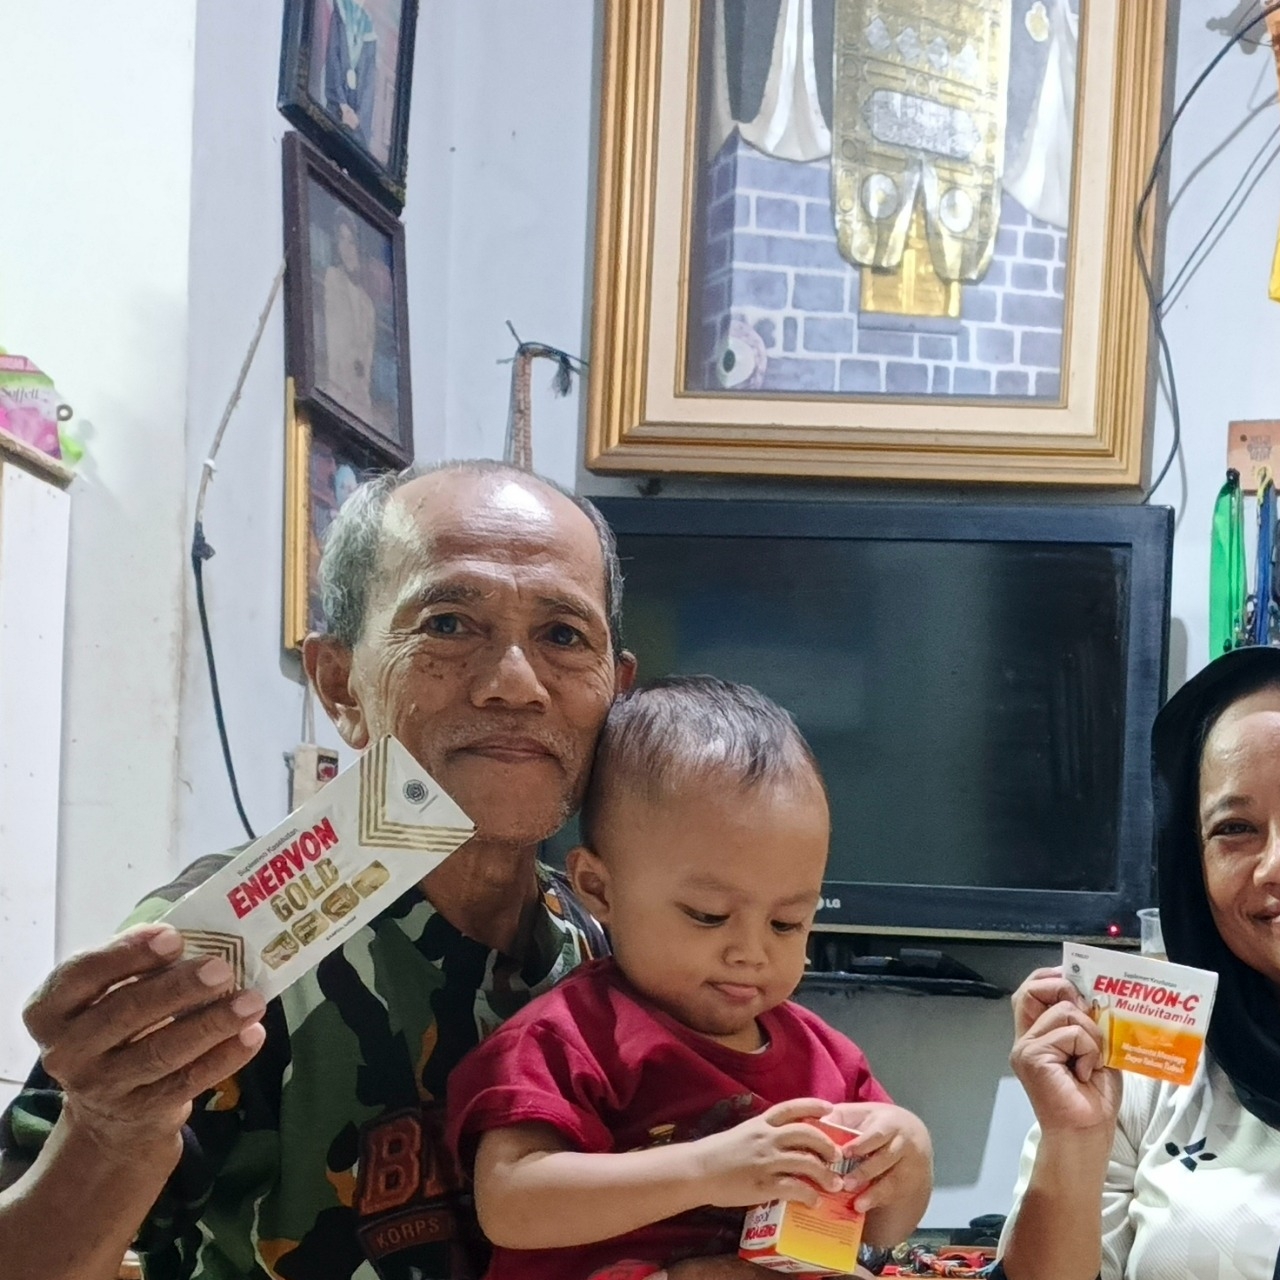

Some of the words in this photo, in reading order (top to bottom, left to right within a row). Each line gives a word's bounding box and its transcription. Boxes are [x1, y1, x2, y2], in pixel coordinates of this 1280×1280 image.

[226, 816, 339, 919] ENERVON
[270, 858, 339, 922] GOLD
[826, 898, 841, 908] LG
[1093, 974, 1200, 1012] ENERVON-C
[1115, 999, 1196, 1027] Multivitamin
[376, 1218, 441, 1250] KORPS
